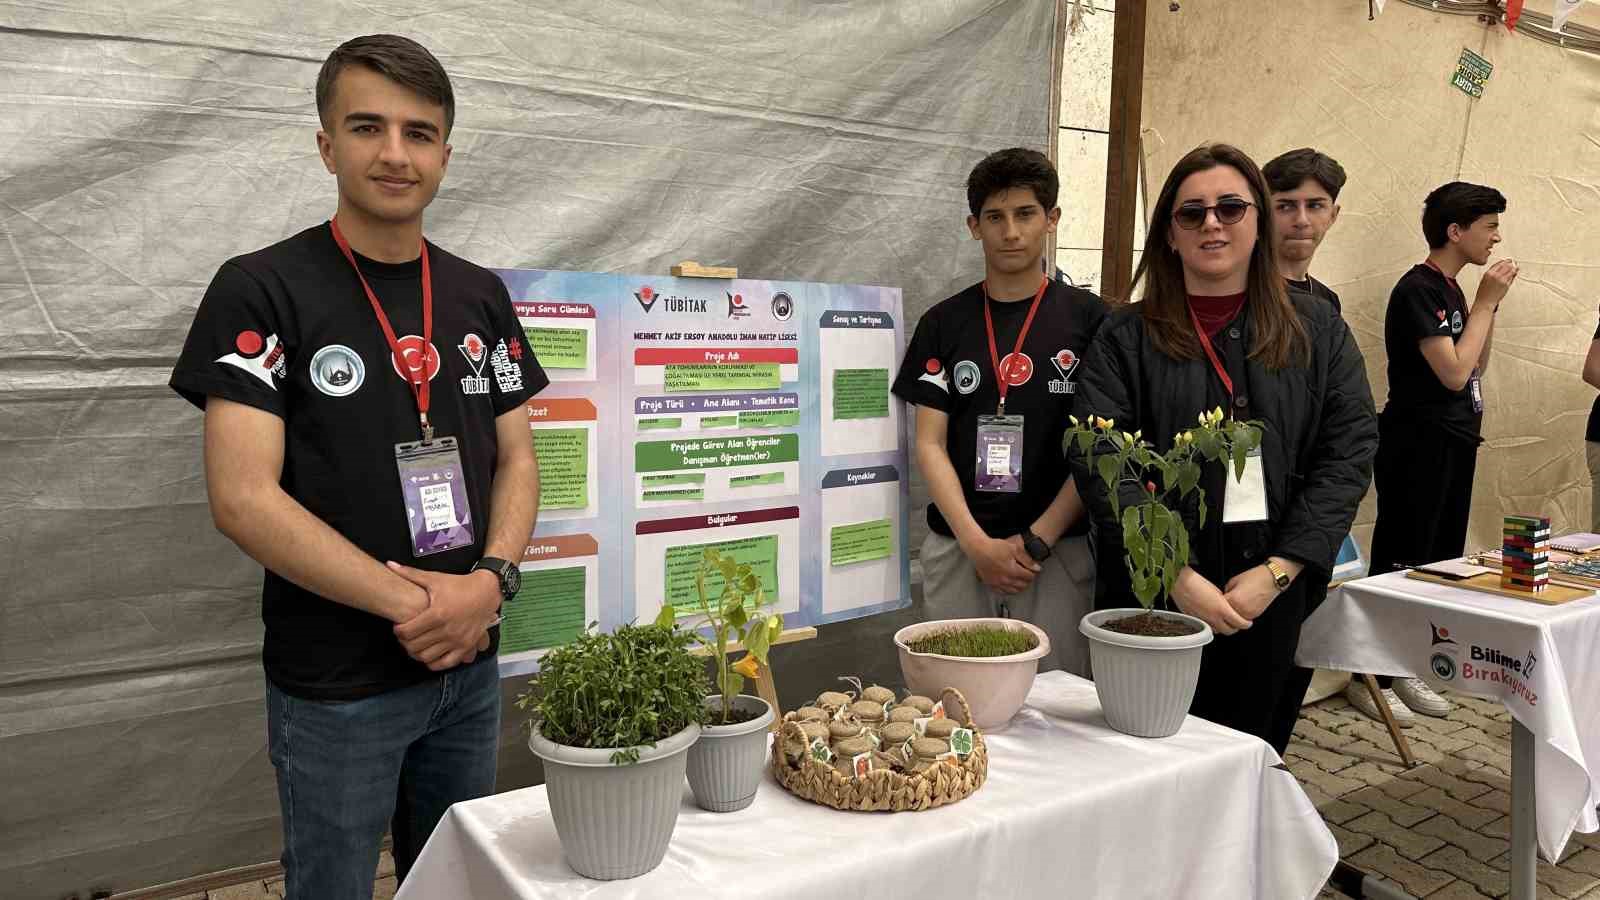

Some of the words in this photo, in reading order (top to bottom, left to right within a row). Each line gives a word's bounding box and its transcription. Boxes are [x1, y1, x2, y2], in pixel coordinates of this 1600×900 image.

[516, 305, 536, 316] veya
[538, 304, 557, 313] Soru
[560, 305, 589, 314] Cümlesi
[664, 295, 707, 313] TÜBİTAK
[832, 314, 850, 326] Sonuç
[634, 332, 662, 341] MEHMET
[665, 332, 682, 341] AKİF
[684, 332, 706, 341] ERSOY
[708, 333, 738, 341] ANADOLU
[704, 352, 725, 364] Proje
[640, 401, 662, 413] Proje
[666, 400, 684, 410] Türü
[704, 400, 718, 408] Ana
[751, 396, 777, 406] Tematik
[779, 397, 794, 405] Konu
[671, 442, 700, 454] Projede
[702, 440, 724, 450] Görev
[728, 440, 744, 449] Alan
[746, 438, 781, 450] Öğrenciler
[684, 455, 718, 466] Danışman
[720, 451, 770, 467] Öğretmen(ler)
[848, 472, 876, 484] Kaynaklar
[707, 514, 738, 528] Bulgular
[1470, 645, 1522, 673] Bilime
[1462, 662, 1538, 706] Bırakıyoruz
